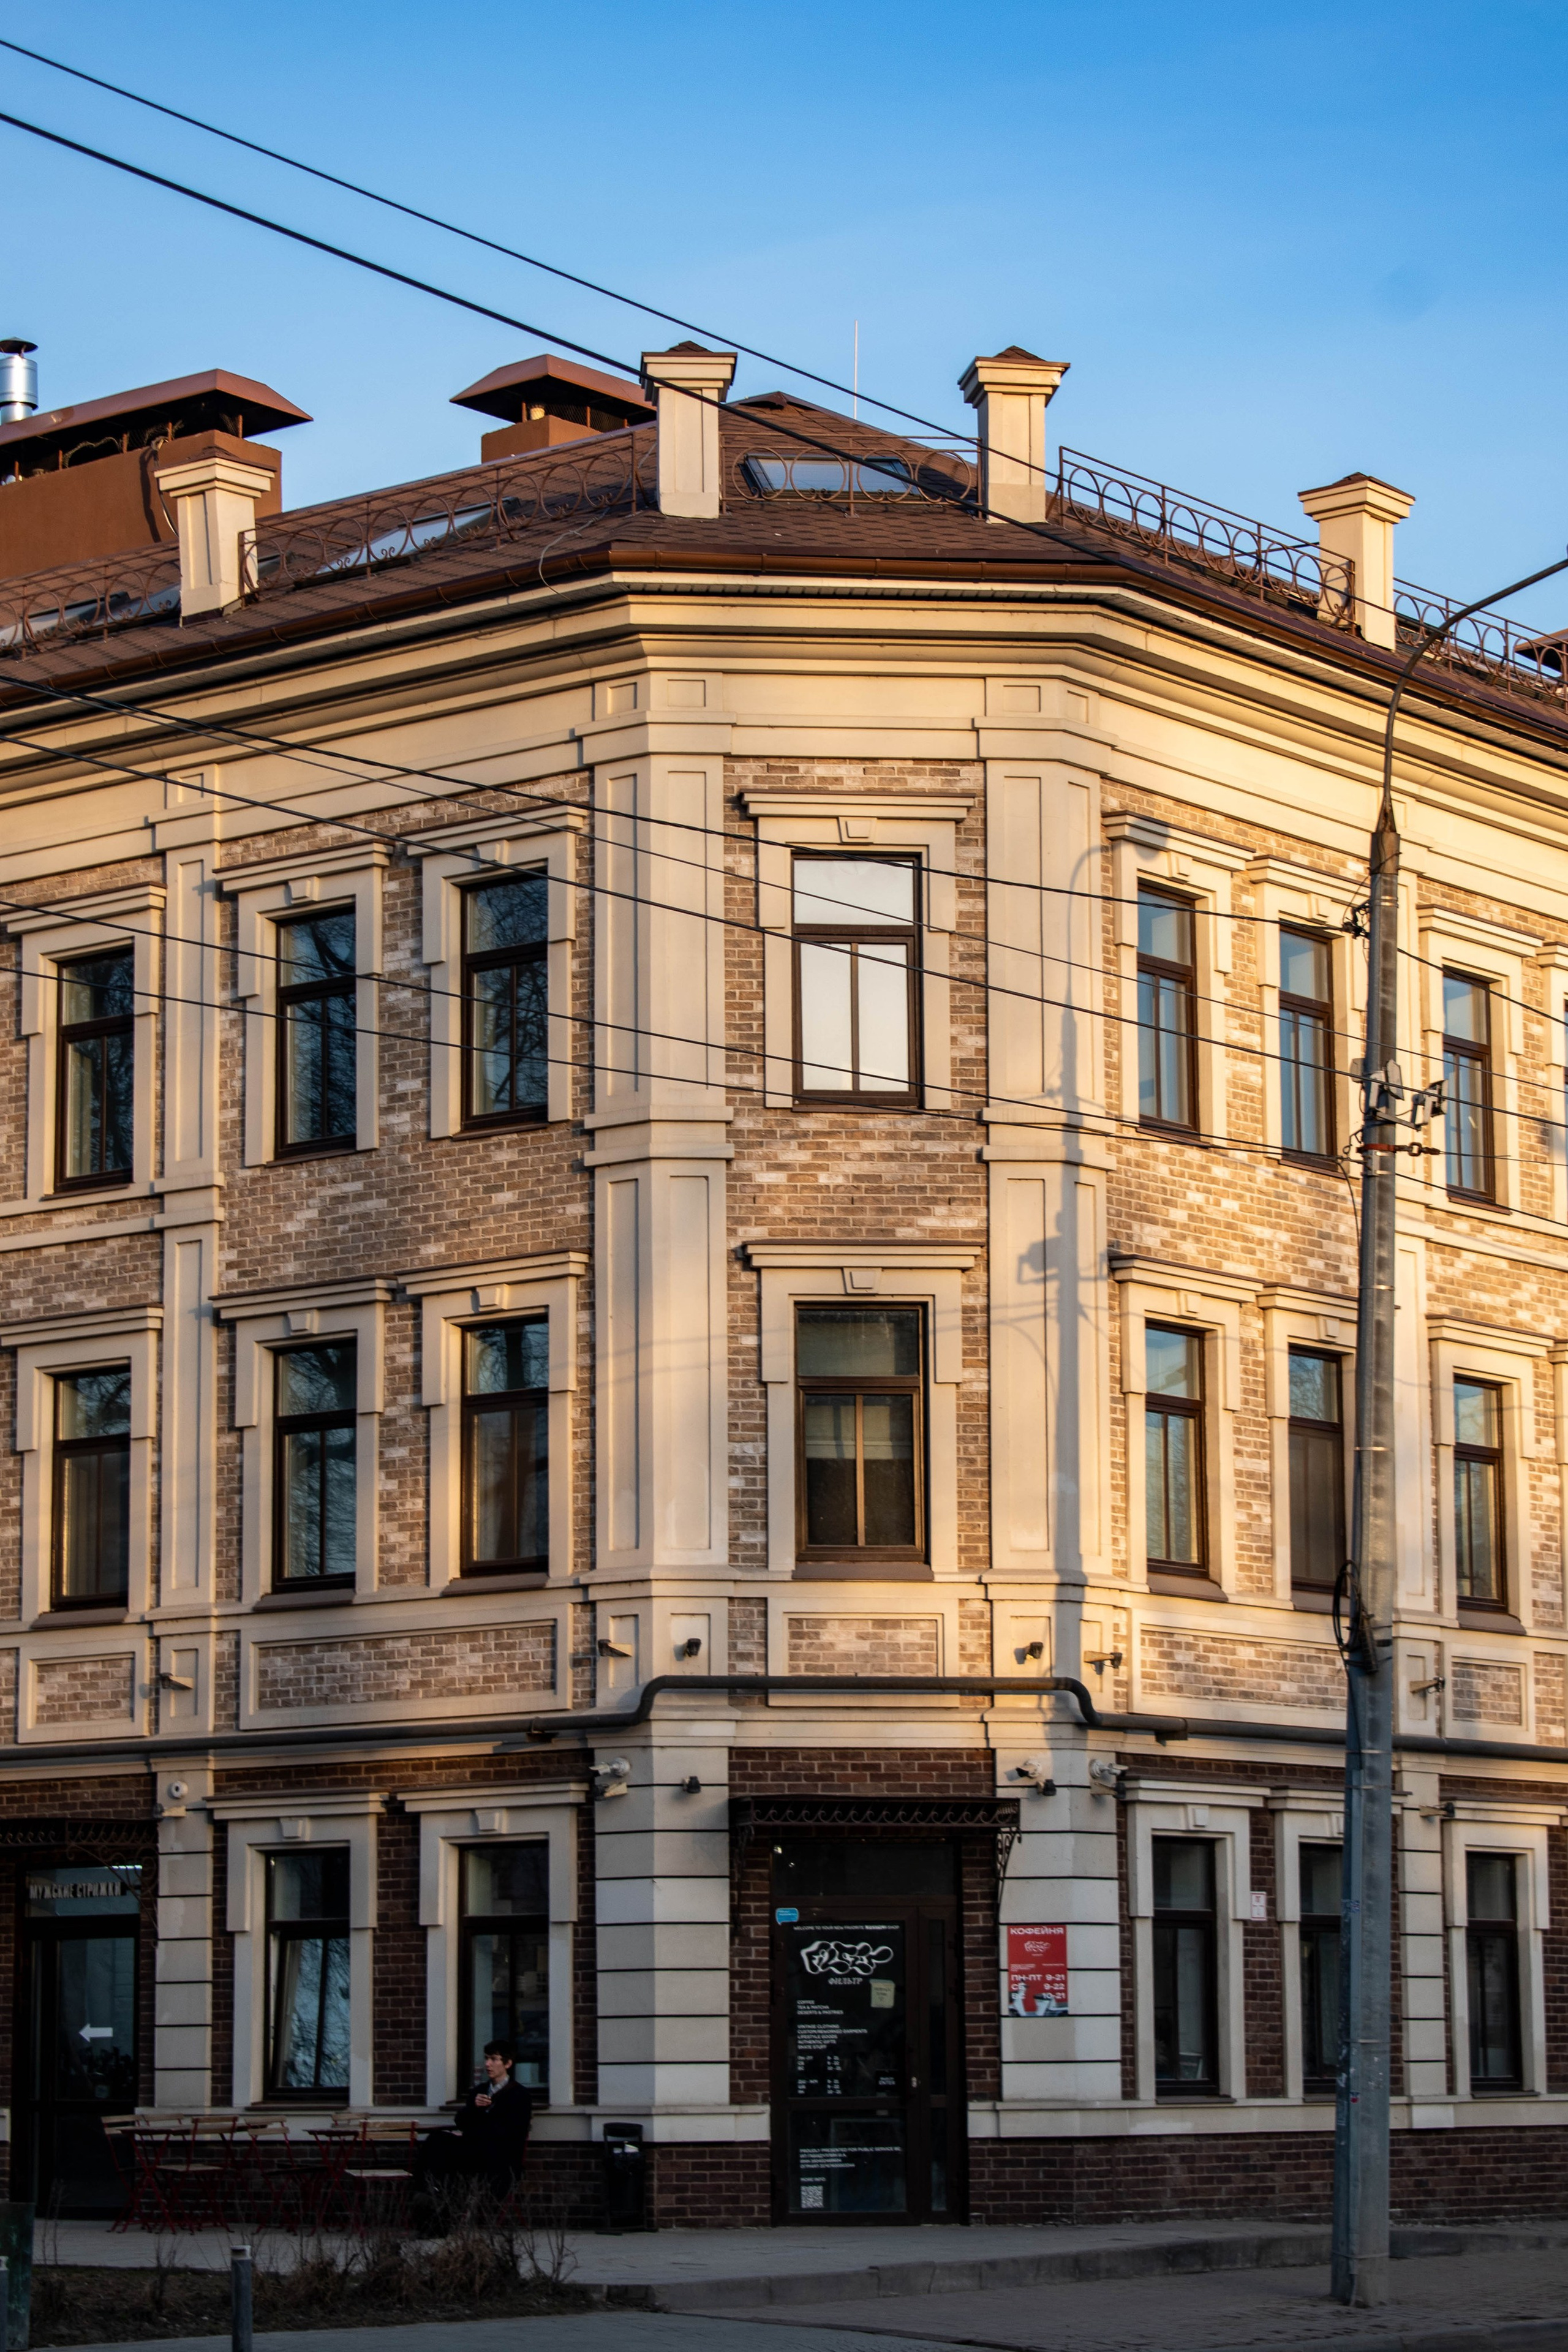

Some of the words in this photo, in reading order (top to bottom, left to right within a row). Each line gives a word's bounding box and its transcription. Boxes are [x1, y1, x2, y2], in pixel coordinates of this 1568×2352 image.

[29, 1883, 75, 1899] МУЖСКИЕ
[76, 1881, 121, 1898] СТРИЖКИ
[1010, 1926, 1064, 1936] КОФЕЙНЯ
